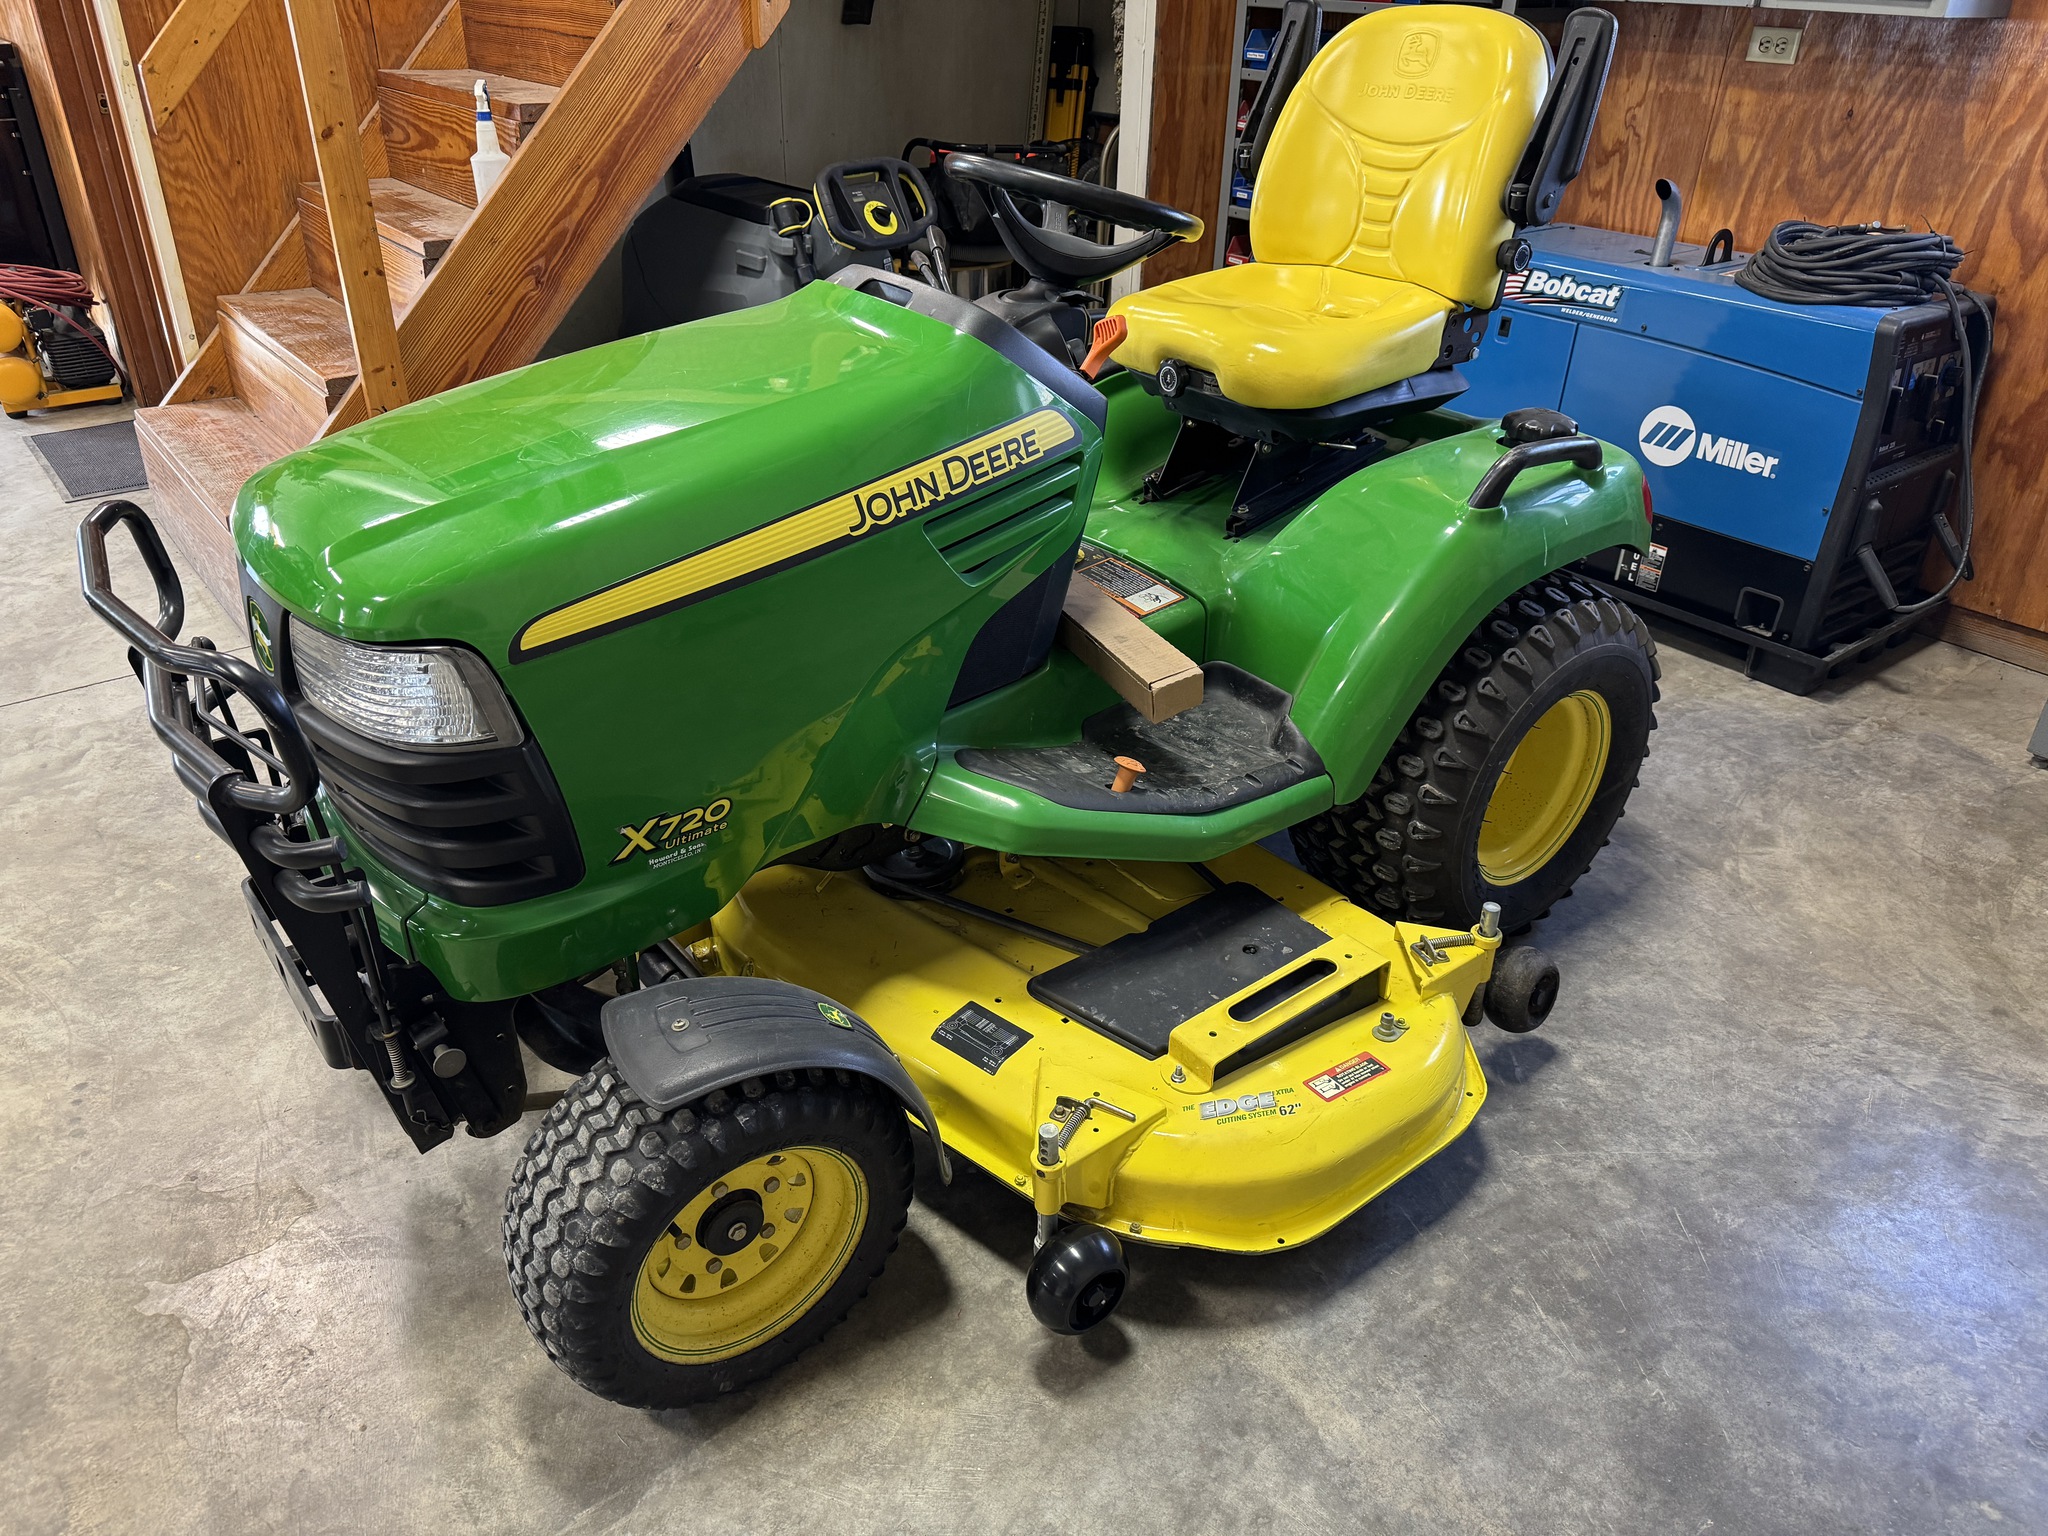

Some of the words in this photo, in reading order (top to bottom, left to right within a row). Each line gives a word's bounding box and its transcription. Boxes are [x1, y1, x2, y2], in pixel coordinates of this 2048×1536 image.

[1359, 82, 1400, 99] JOHN
[1403, 83, 1455, 103] DEERE
[1523, 269, 1623, 308] Bobcat
[1560, 307, 1619, 324] WELDER/GENERATOR
[1696, 432, 1779, 478] Miller
[849, 470, 942, 533] JOHN
[942, 428, 1041, 494] DEERE
[610, 798, 732, 863] X720
[665, 821, 728, 850] Ultimate
[648, 850, 678, 865] Howard
[1339, 1057, 1361, 1069] DANGER
[1182, 1104, 1195, 1112] THE
[1199, 1091, 1277, 1120] EDGE
[1275, 1087, 1294, 1096] XTRA
[1216, 1114, 1247, 1125] CUTTING
[1248, 1109, 1277, 1119] SYSTEM
[1279, 1103, 1301, 1116] 62"
